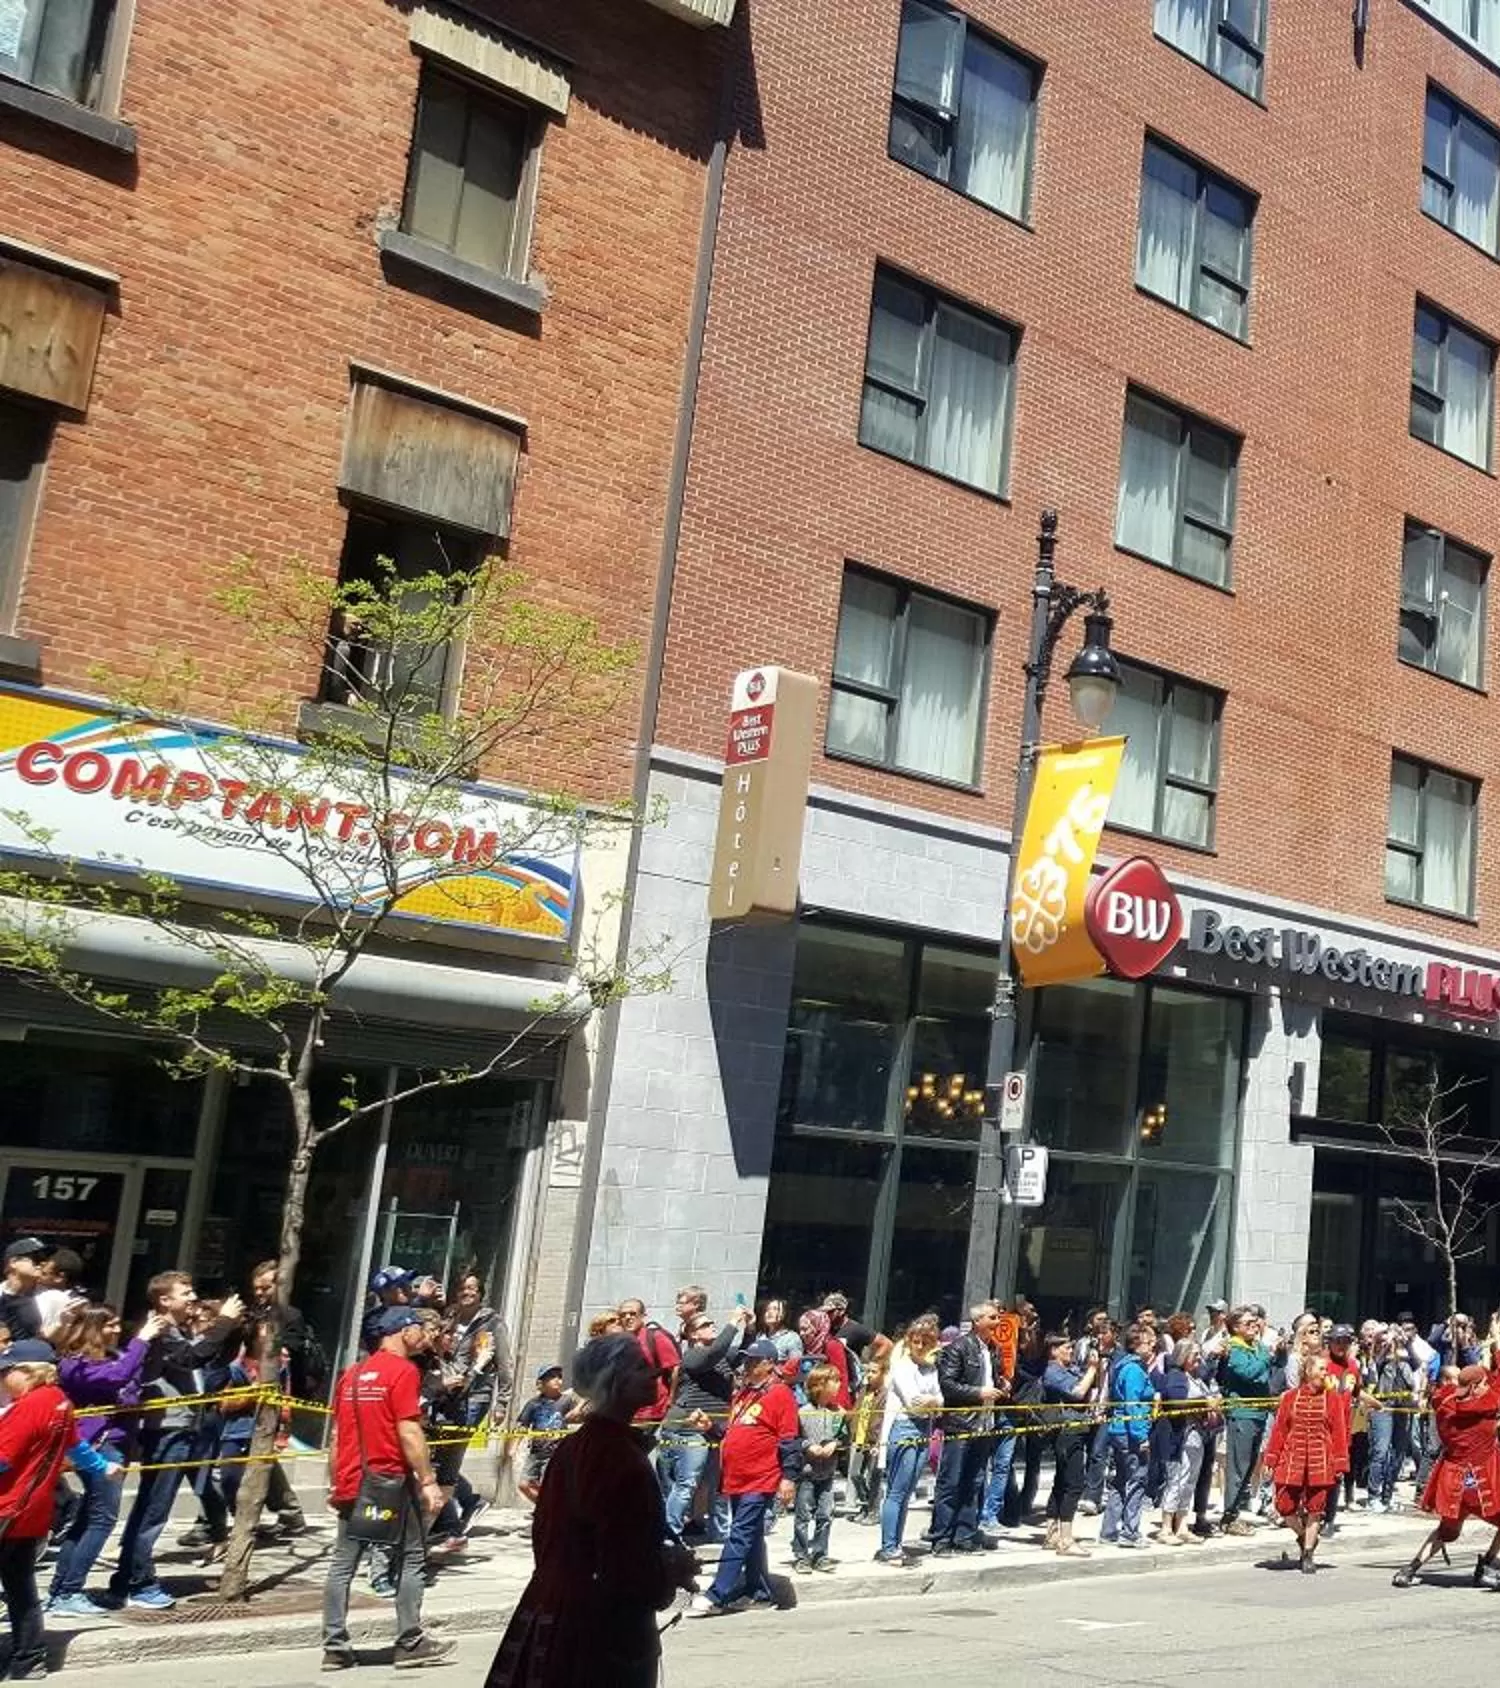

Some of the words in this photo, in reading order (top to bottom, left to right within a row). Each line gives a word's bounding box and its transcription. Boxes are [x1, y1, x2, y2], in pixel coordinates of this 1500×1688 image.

[16, 741, 499, 864] COMPTANT.COM
[1107, 891, 1171, 941] BW
[1188, 909, 1283, 968] Best
[1281, 929, 1426, 997] Western
[32, 1174, 99, 1201] 157
